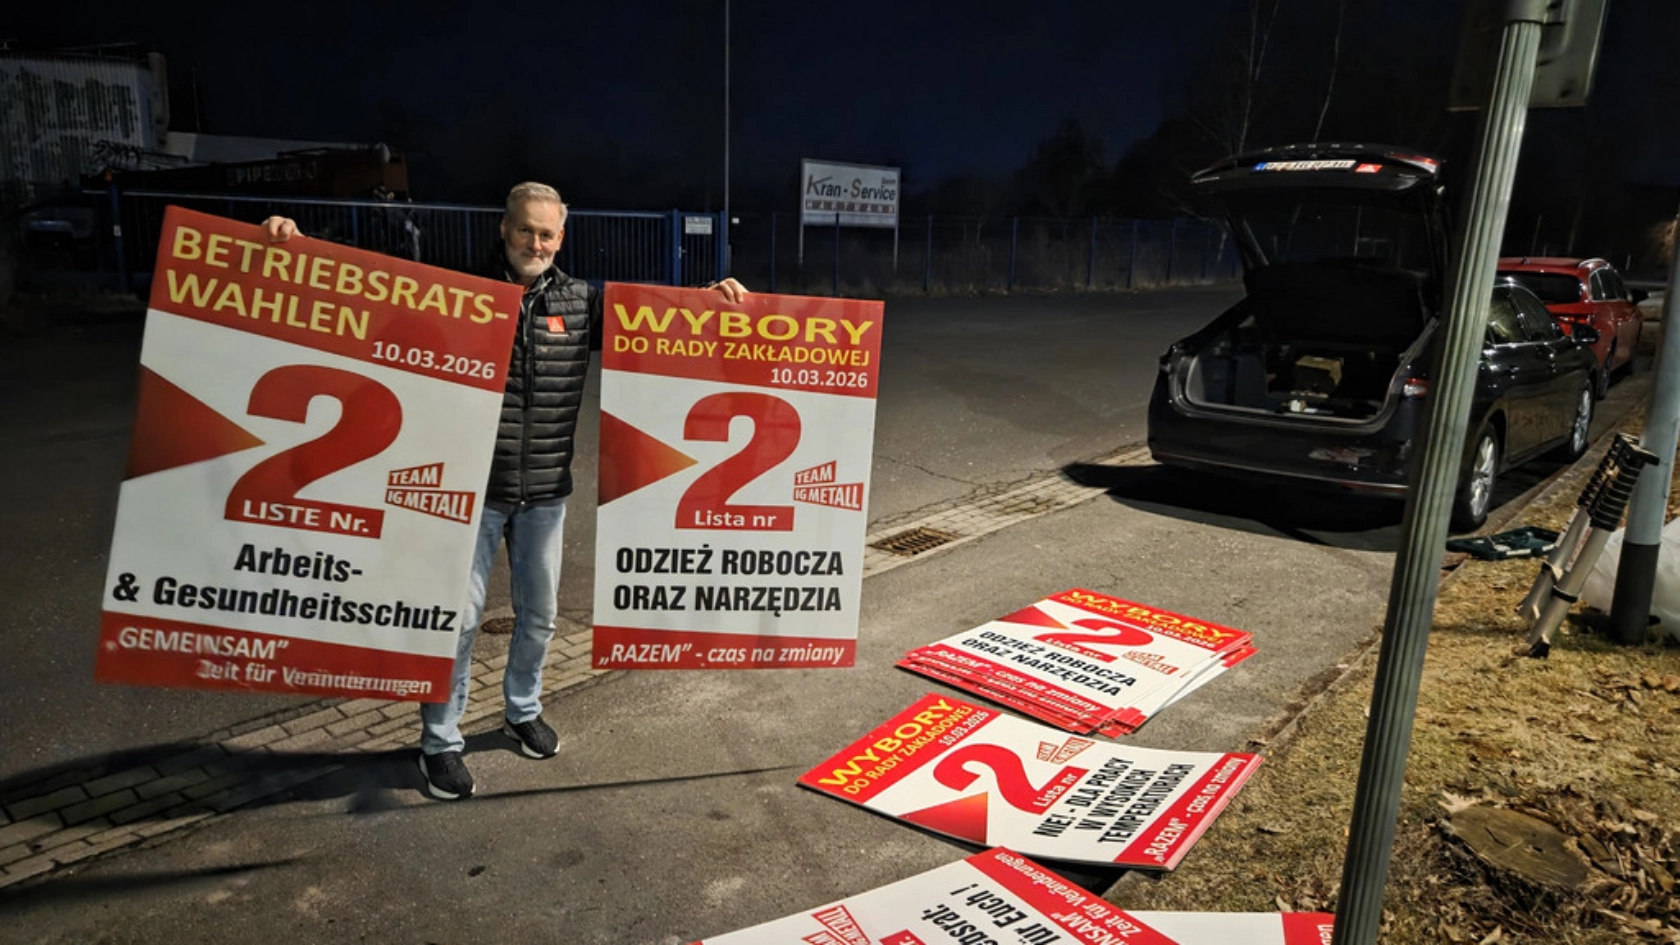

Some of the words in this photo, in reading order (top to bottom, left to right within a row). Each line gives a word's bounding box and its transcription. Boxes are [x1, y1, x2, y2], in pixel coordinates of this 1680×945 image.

[806, 174, 841, 197] Kran
[851, 178, 896, 200] Service
[172, 226, 509, 324] BETRIEBSRATS-
[167, 269, 370, 341] WAHLEN
[613, 303, 874, 345] WYBORY
[372, 341, 496, 379] 10.03.2026
[614, 335, 649, 354] DO
[656, 338, 718, 358] RADY
[723, 341, 870, 367] ZAKŁADOWEJ
[770, 368, 868, 388] 10.03.2026
[225, 364, 403, 539] 2
[675, 392, 802, 532] 2
[392, 466, 438, 485] TEAM
[796, 464, 833, 484] TEAM
[387, 490, 403, 503] IG
[403, 491, 469, 521] METALL
[795, 488, 807, 500] IG
[808, 485, 860, 508] METALL
[242, 500, 320, 528] LISTE
[329, 510, 370, 533] Nr.
[694, 510, 745, 527] Lista
[753, 514, 777, 528] nr
[234, 544, 363, 583] Arbeits-
[616, 544, 712, 575] ODZIEŻ
[721, 550, 844, 576] ROBOCZA
[113, 572, 140, 602] &
[153, 577, 457, 632] Gesundheitsschutz
[613, 585, 687, 611] ORAZ
[694, 586, 842, 617] NARZĘDZIA
[1071, 591, 1236, 639] WYBORY
[751, 647, 773, 662] na
[779, 644, 845, 665] zmiany
[1033, 618, 1154, 663] 2
[1045, 637, 1081, 653] Lista
[245, 662, 276, 683] für
[961, 637, 1013, 658] ORAZ
[1011, 653, 1122, 696] NARZĘDZIA
[979, 631, 1046, 655] ODZIEŻ
[1043, 650, 1137, 687] ROBOCZA
[1026, 680, 1045, 690] na
[1045, 686, 1101, 712] zmiany
[818, 698, 954, 787] WYBORY
[843, 777, 870, 795] DO
[865, 754, 904, 780] RADY
[897, 705, 973, 757] ZAKŁADOWEJ
[933, 743, 1090, 815] 2
[1210, 757, 1248, 783] zmiany
[1032, 784, 1066, 807] Lista
[1064, 773, 1078, 785] nr
[1032, 813, 1077, 837] NIE!
[1065, 788, 1105, 807] DLA
[1085, 757, 1134, 788] PRACY
[1087, 769, 1157, 817] WYSOKICH
[1097, 763, 1195, 843] TEMPERATURACH
[1074, 818, 1106, 830] W
[950, 883, 979, 896] !
[994, 852, 1087, 907] Veränderungen
[966, 890, 1028, 928] Euch
[1082, 903, 1112, 919] für
[1104, 915, 1142, 938] Zeit
